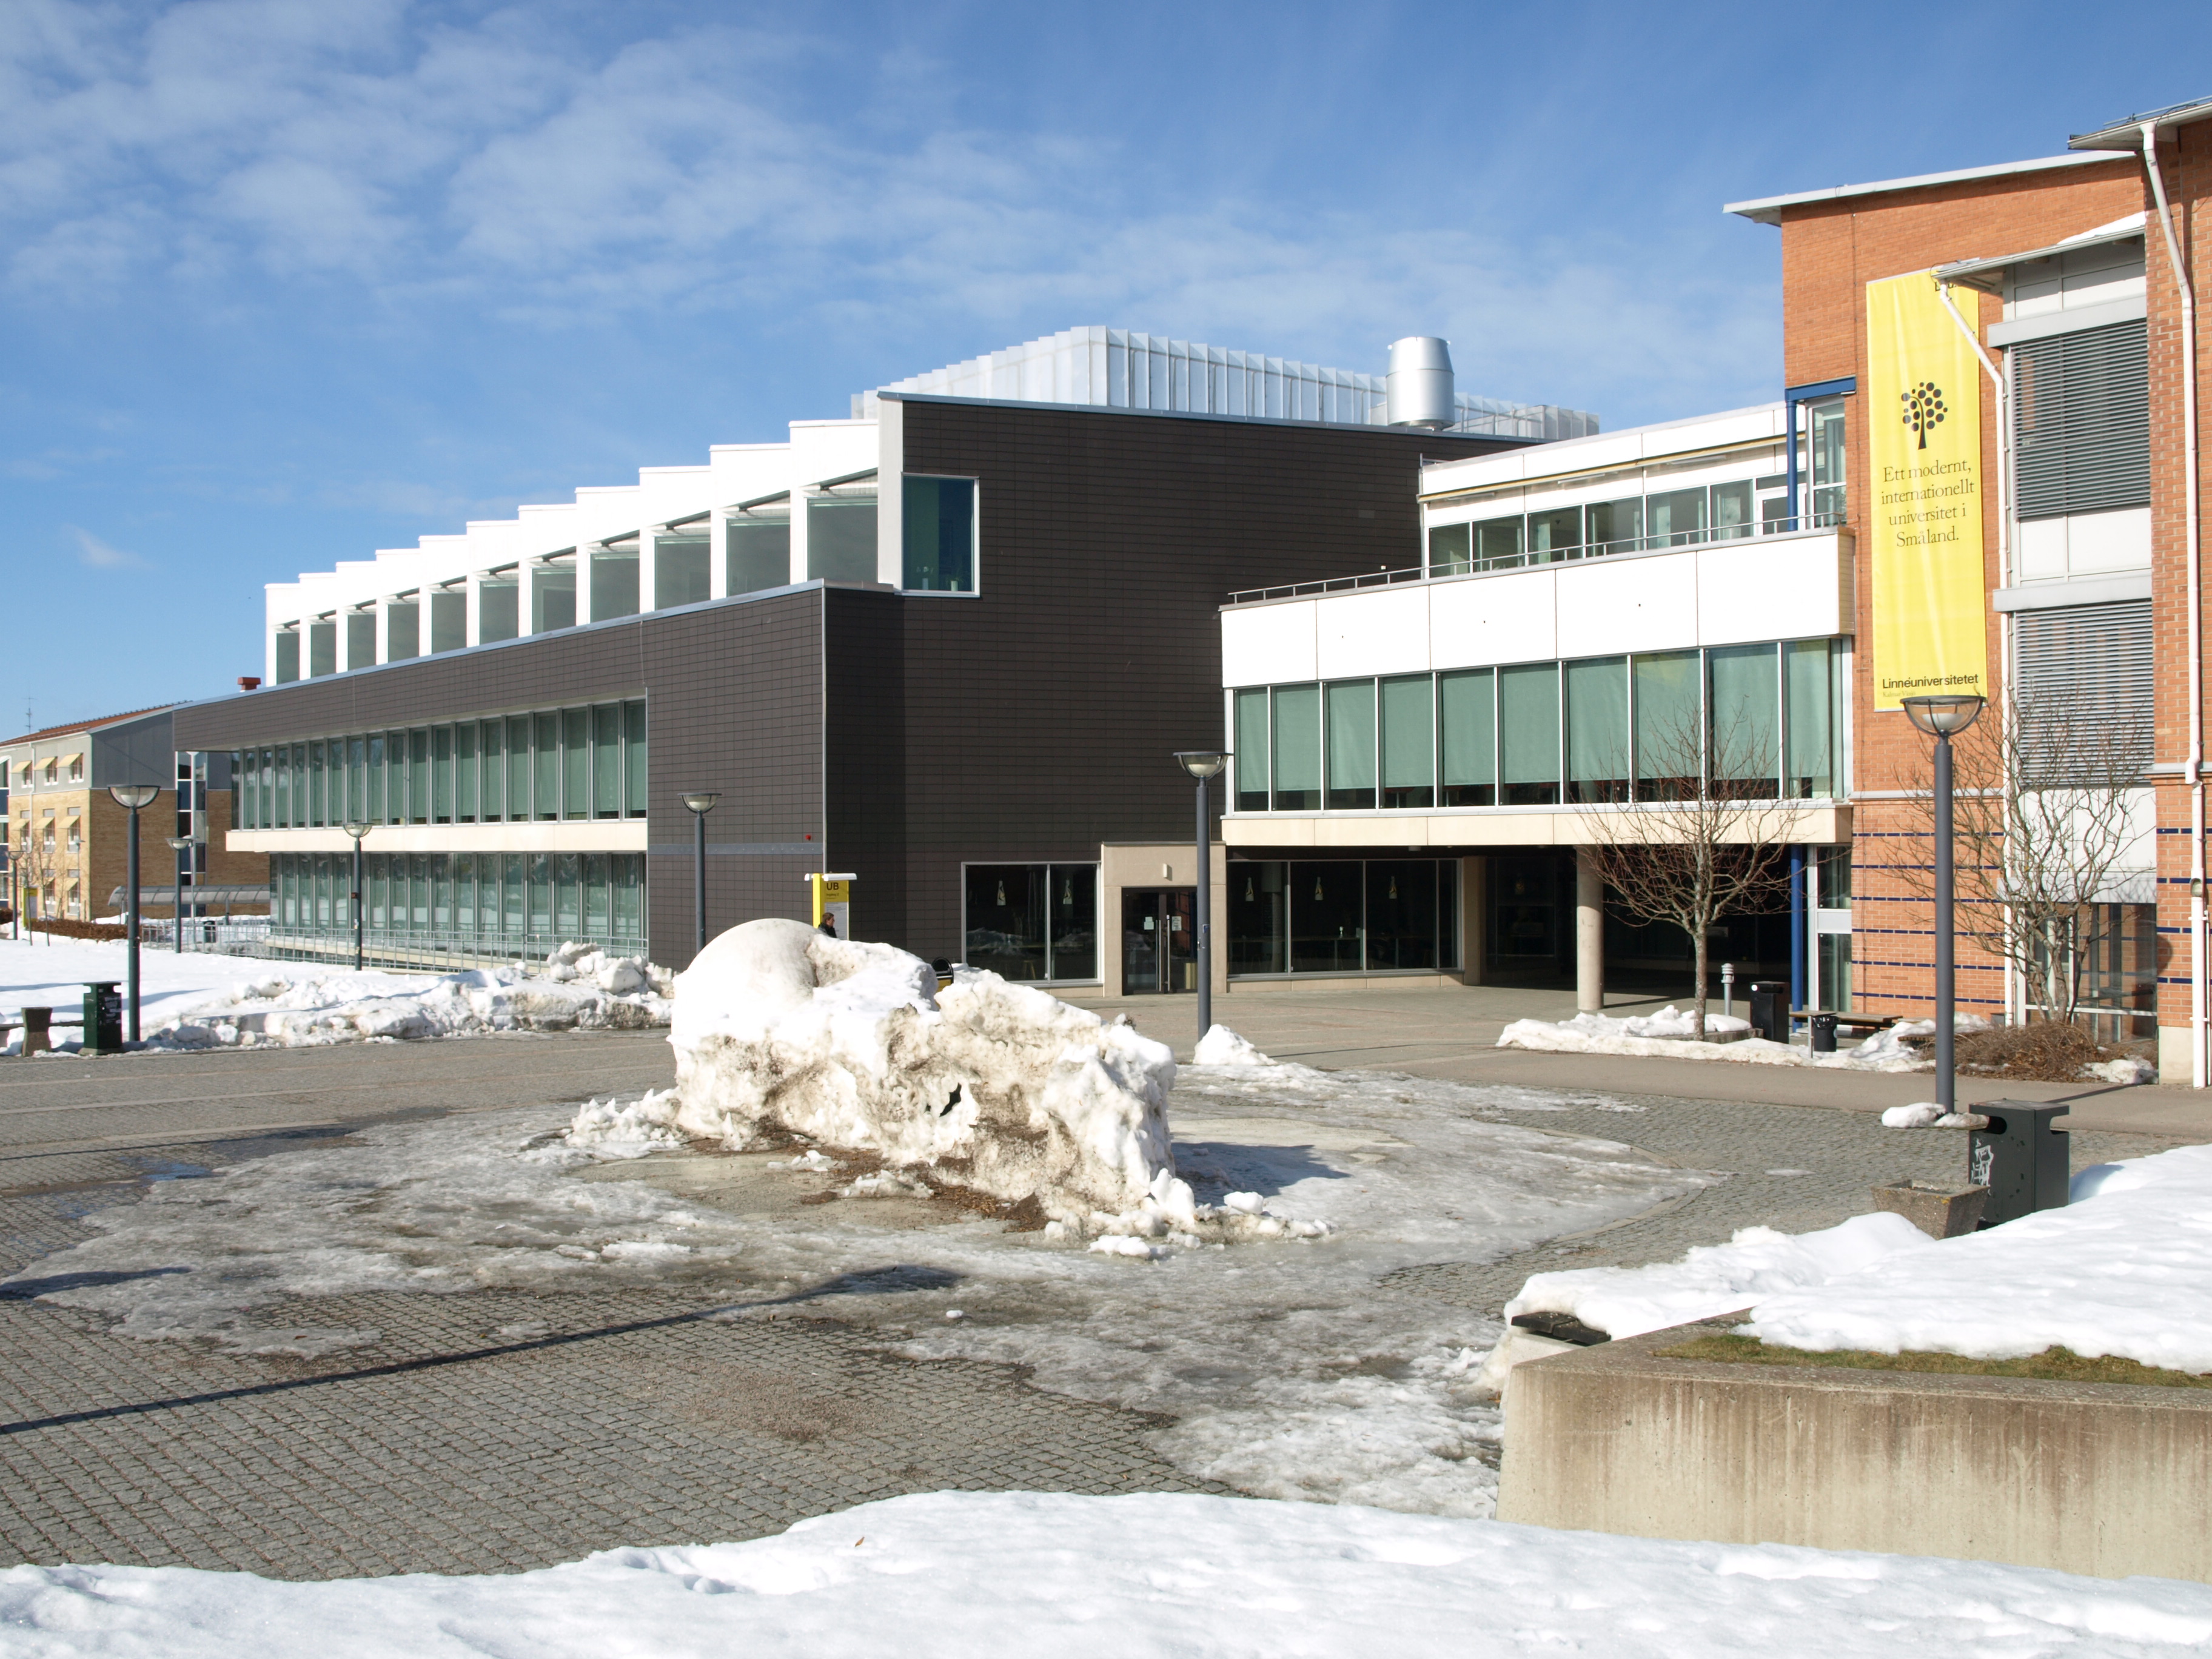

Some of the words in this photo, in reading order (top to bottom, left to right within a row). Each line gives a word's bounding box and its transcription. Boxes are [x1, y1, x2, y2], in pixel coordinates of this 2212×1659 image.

[1883, 466, 1905, 482] Ett
[1908, 460, 1971, 478] modernt,
[1882, 478, 1974, 504] internationellt
[1889, 506, 1957, 526] universitet
[1962, 503, 1966, 517] i
[1897, 526, 1959, 547] Småland.
[1883, 674, 1979, 689] Linnéuniversitetet
